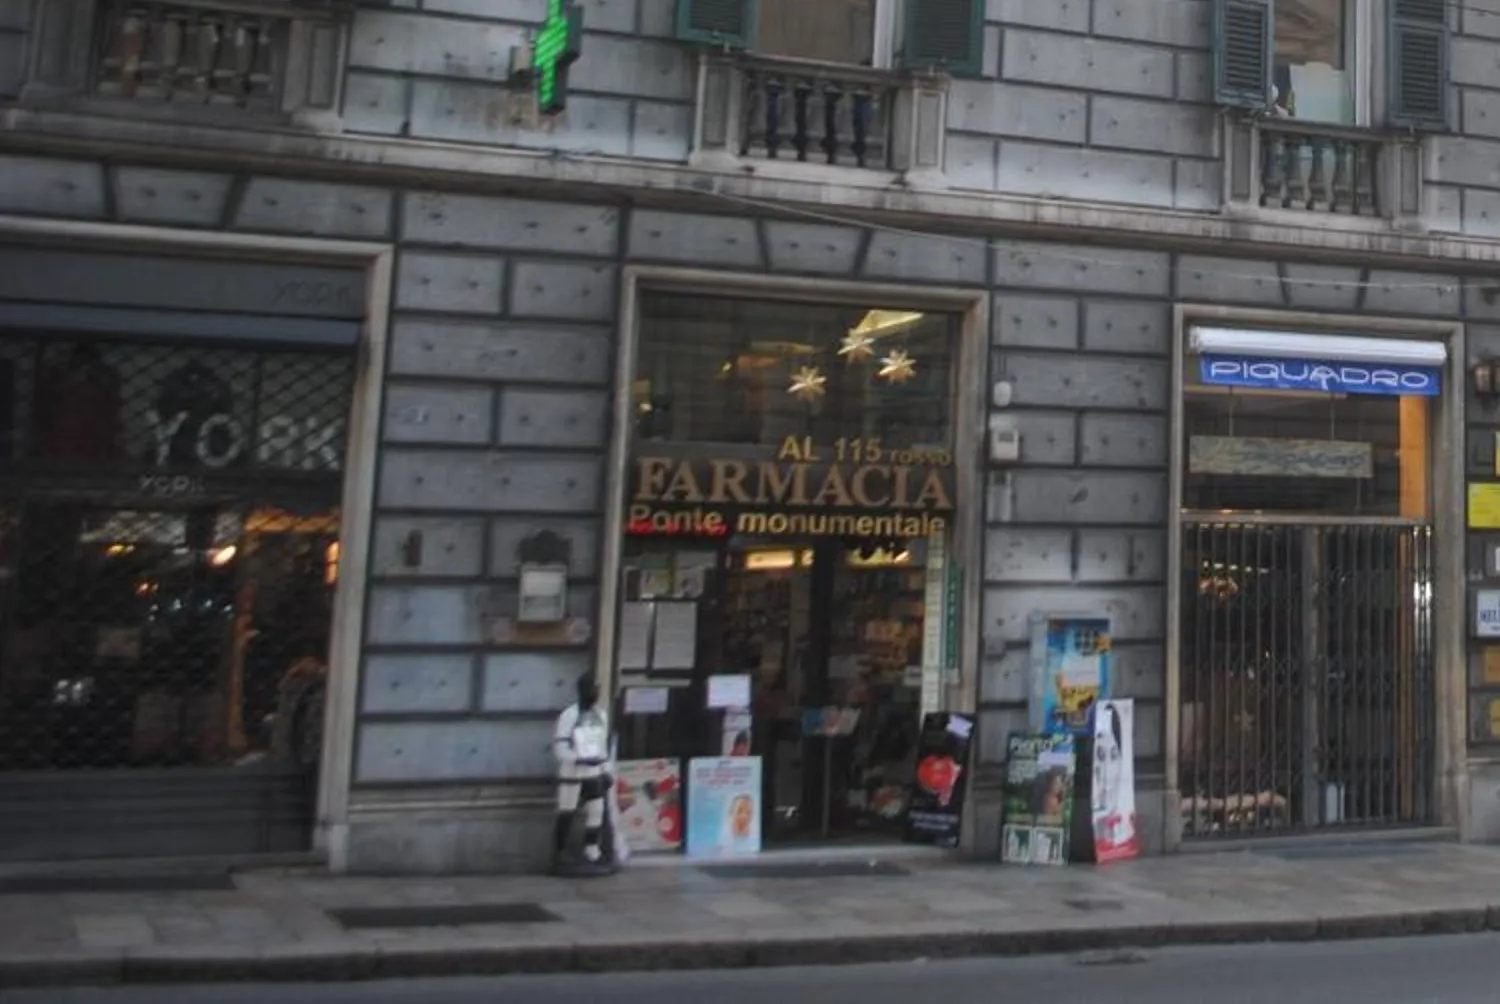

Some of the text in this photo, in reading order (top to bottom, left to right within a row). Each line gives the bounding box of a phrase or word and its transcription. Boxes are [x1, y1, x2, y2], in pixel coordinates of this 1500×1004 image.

[1211, 360, 1430, 390] PIQUADRO
[146, 410, 345, 471] YORK
[778, 435, 822, 461] AL
[834, 437, 882, 463] 115
[635, 456, 955, 510] FARMACIA
[737, 511, 946, 537] monumentale
